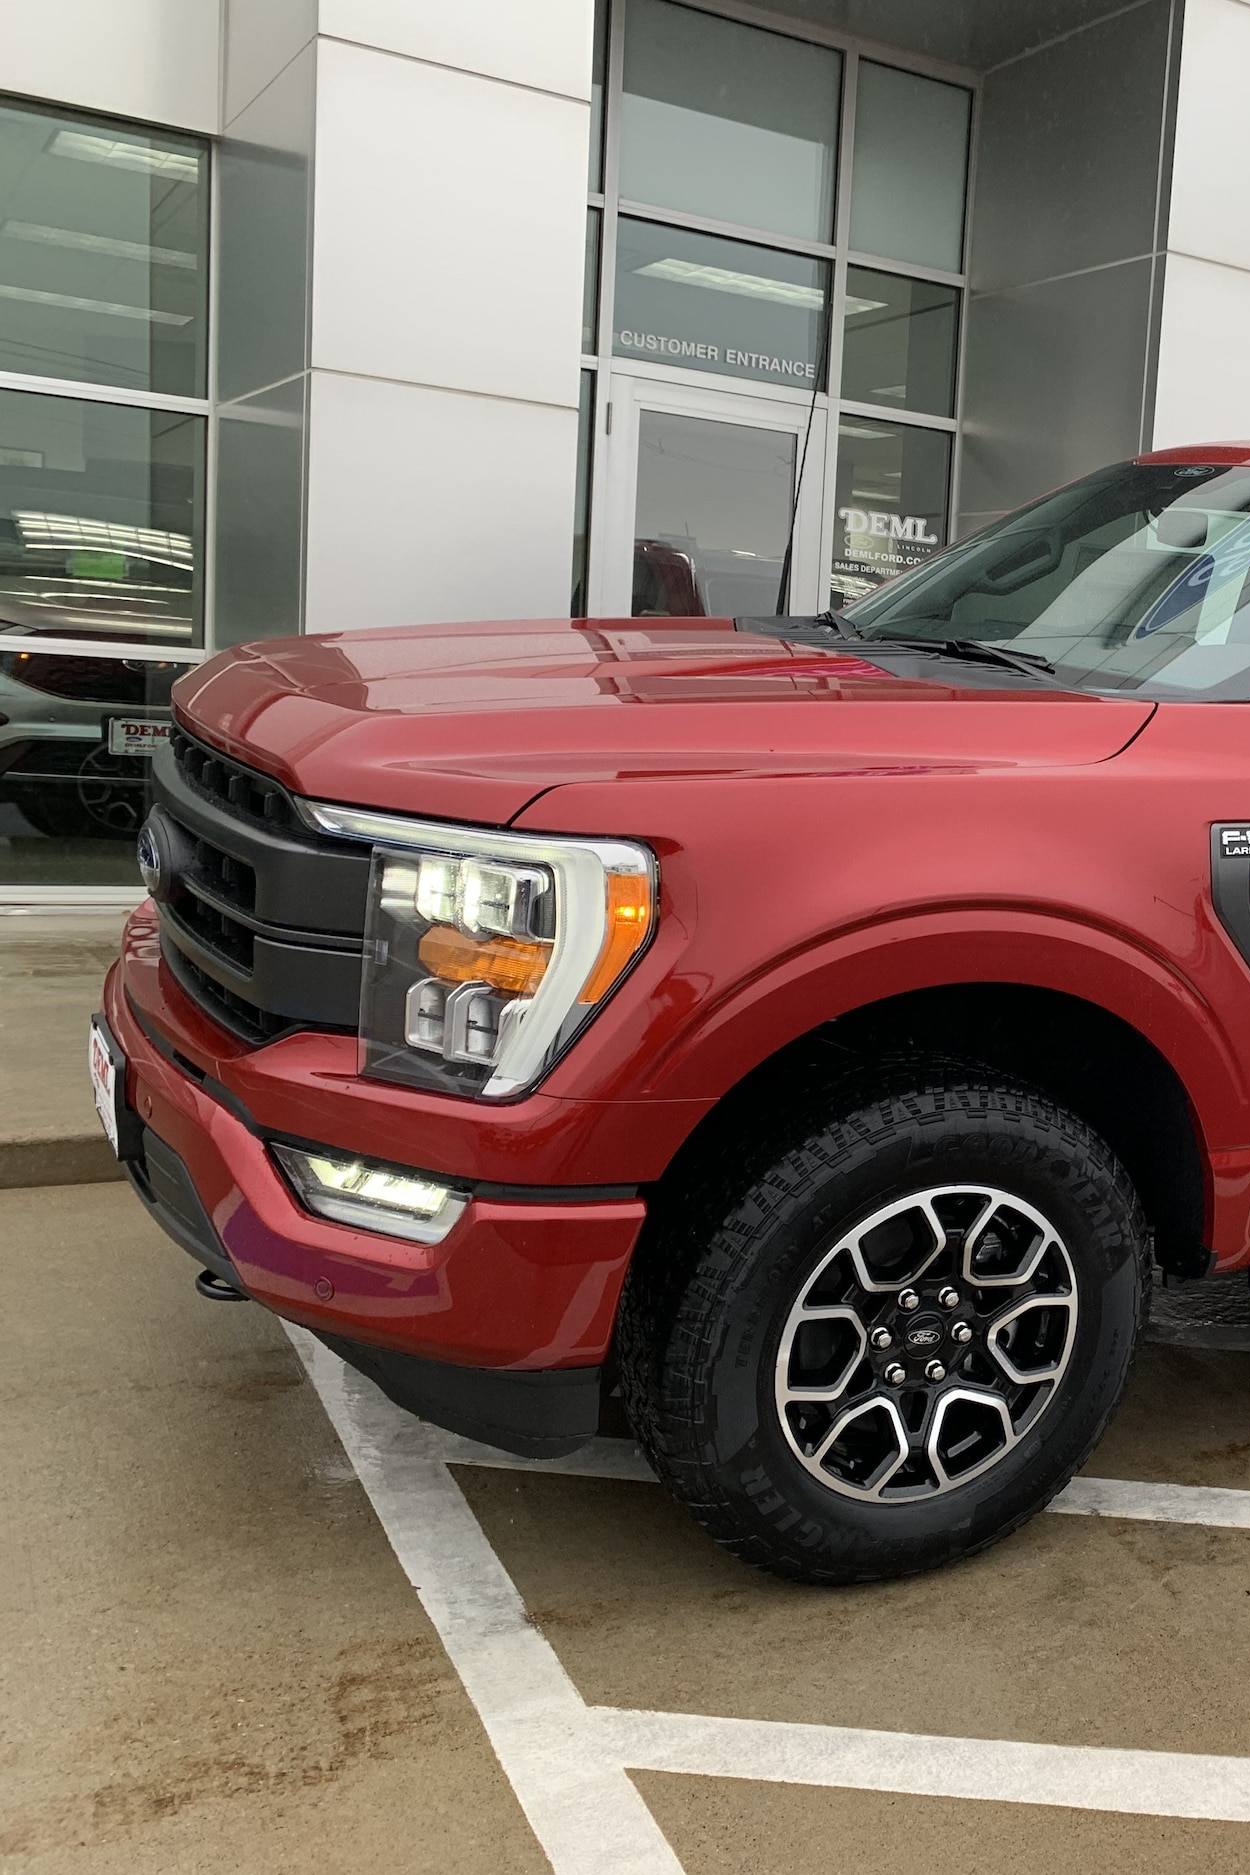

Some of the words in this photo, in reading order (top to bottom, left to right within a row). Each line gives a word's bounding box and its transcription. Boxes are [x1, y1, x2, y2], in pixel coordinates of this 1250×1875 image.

[620, 330, 719, 361] CUSTOMER
[726, 348, 815, 378] ENTRANCE
[839, 508, 938, 544] DEML
[844, 548, 923, 565] DEMLFORD.CO
[897, 544, 931, 553] LINCOLN
[834, 561, 859, 572] SALES
[861, 564, 903, 576] DEPARTME
[121, 723, 171, 738] DEM
